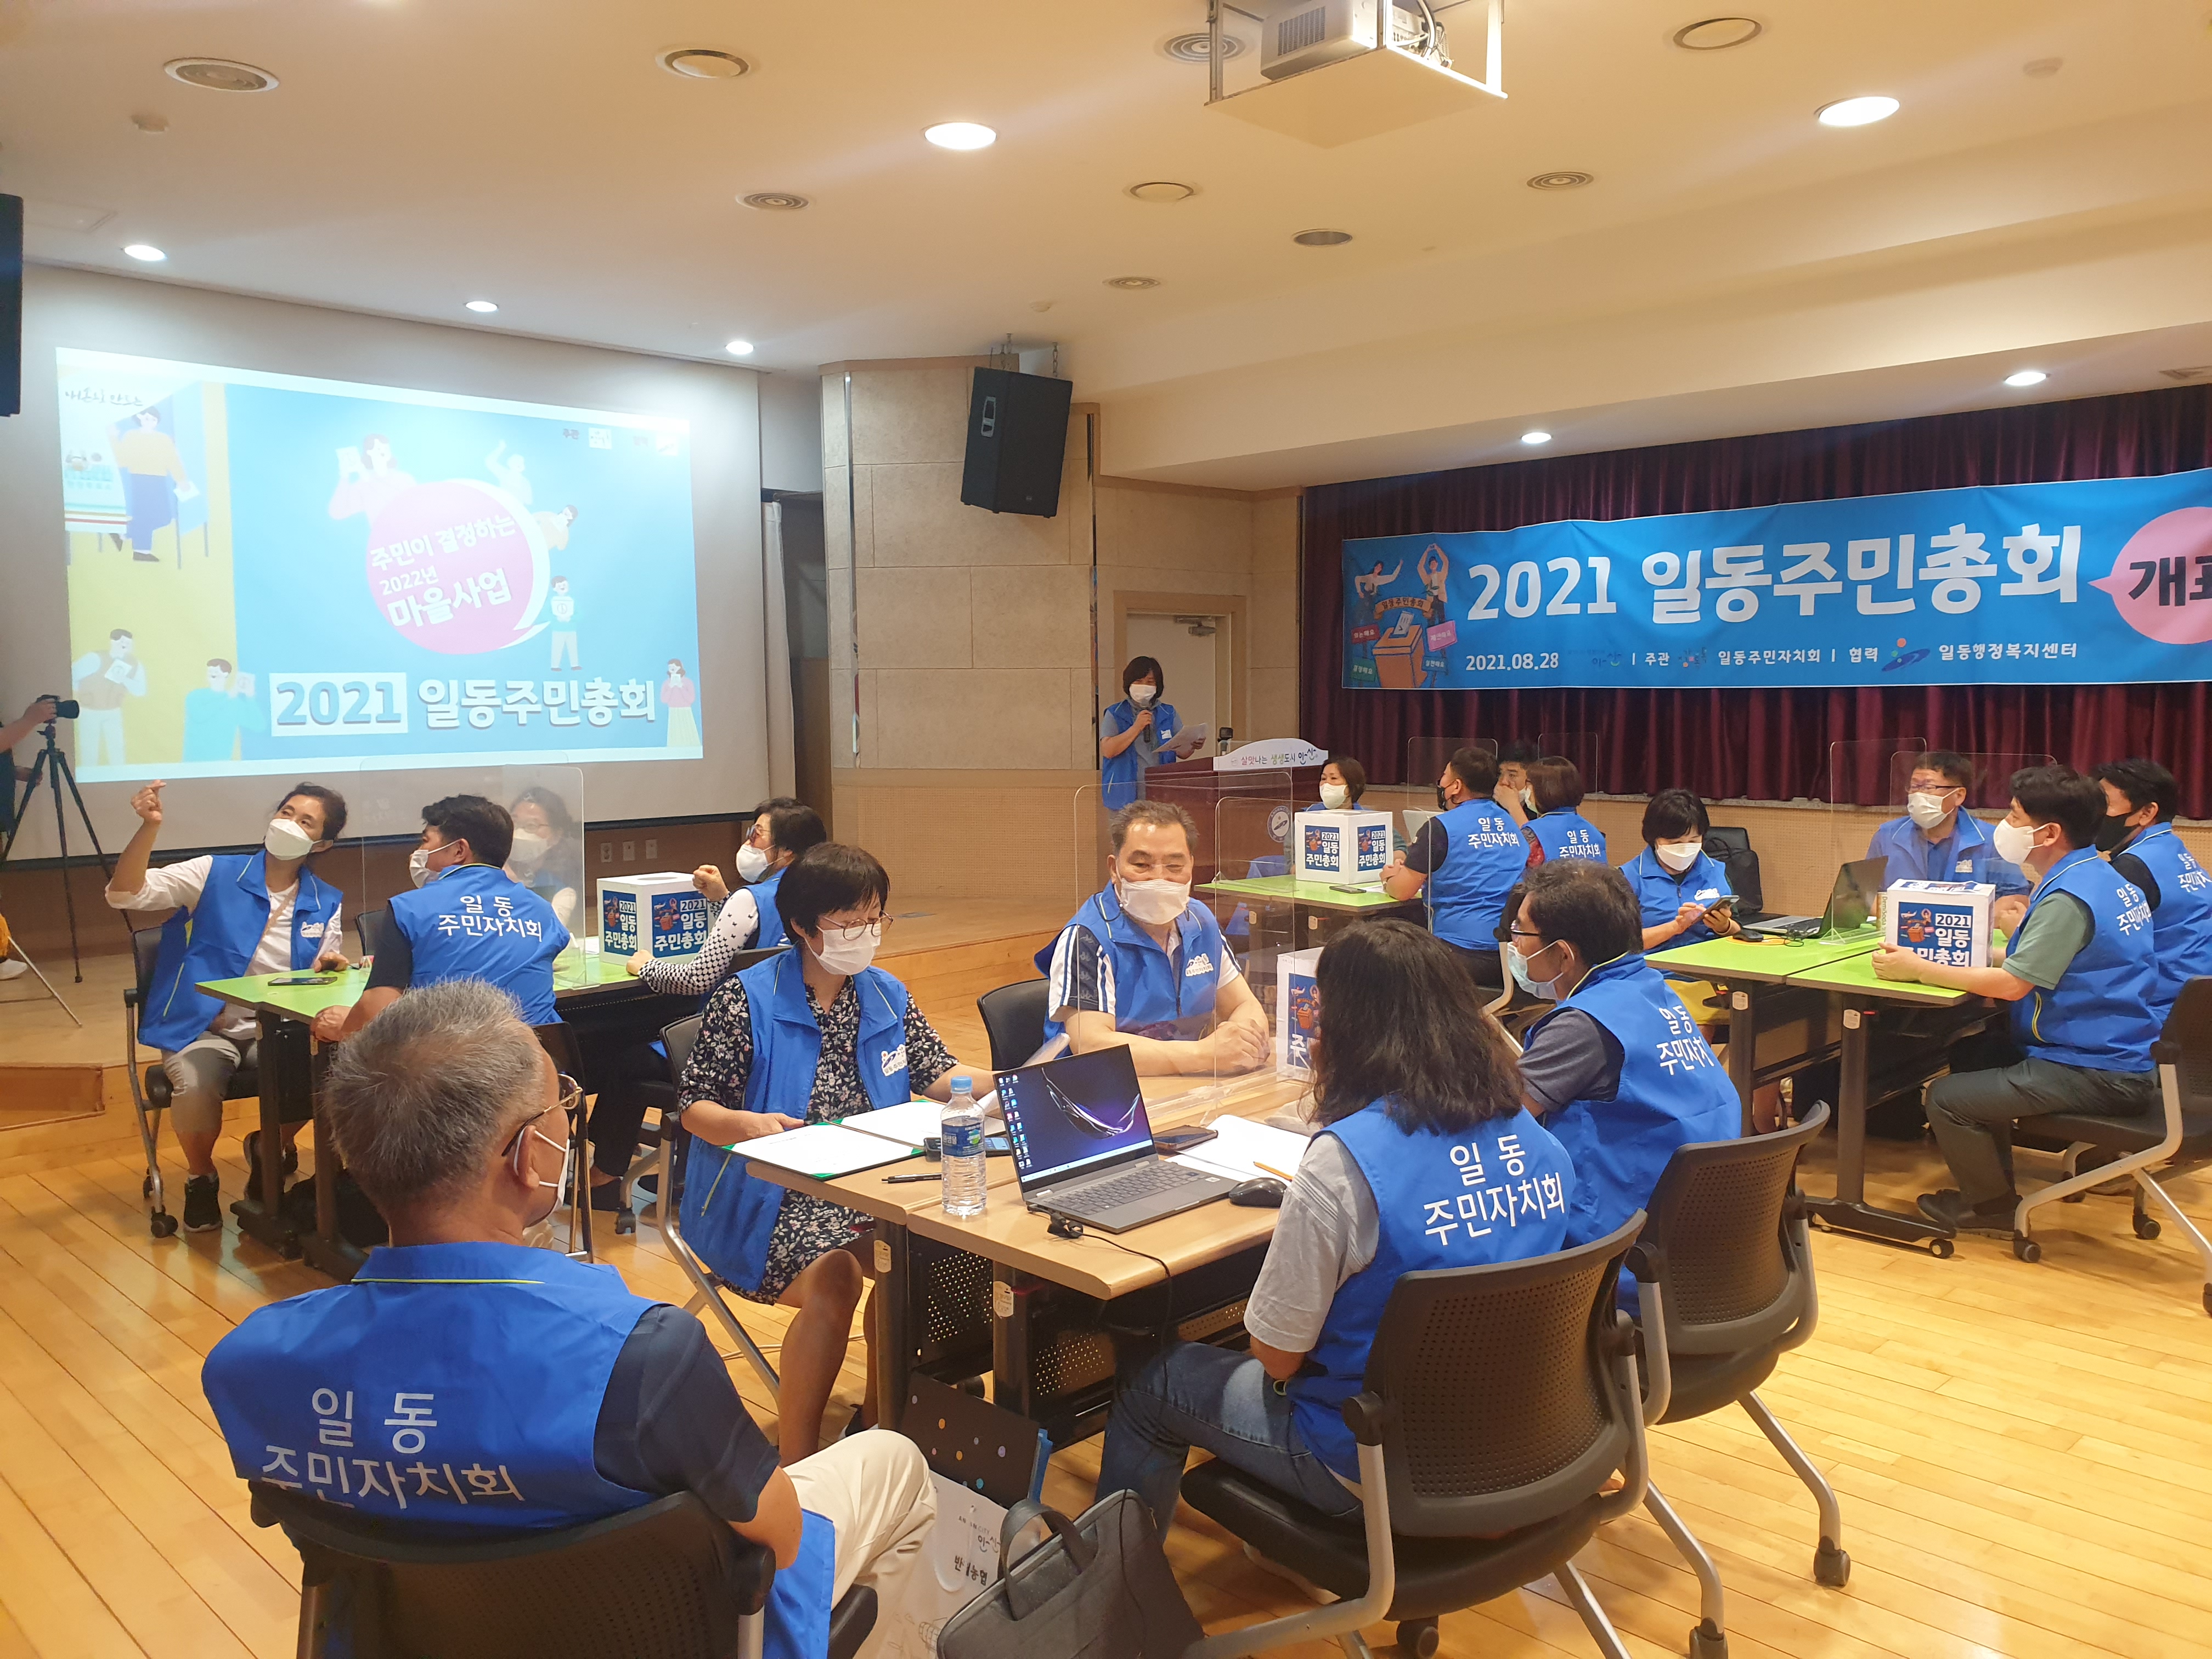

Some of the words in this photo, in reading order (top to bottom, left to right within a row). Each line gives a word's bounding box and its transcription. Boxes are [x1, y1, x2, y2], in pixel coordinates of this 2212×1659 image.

[370, 537, 434, 571] 주민이
[436, 515, 514, 554] 결정하는
[380, 566, 438, 596] 2022년
[1468, 556, 1617, 621] 2021
[1641, 523, 2081, 624] 일동주민총회
[387, 568, 511, 627] 마을사업
[1466, 652, 1559, 671] 2021.08.28
[1645, 652, 1669, 667] 주관
[1718, 648, 1821, 665] 일동주민자치회
[1849, 647, 1878, 663] 협력
[1938, 642, 2078, 661] 일동행정복지센터
[276, 681, 402, 725] 2021
[418, 676, 656, 729] 일동주민총회
[1241, 755, 1268, 765] 살맛나는
[1271, 753, 1295, 766] 생생도시
[1322, 832, 1339, 840] 2021
[1372, 839, 1386, 852] 일동
[1468, 832, 1520, 848] 주민자치회
[1322, 841, 1339, 854] 일동
[1559, 843, 1601, 858] 주민자치회
[1306, 854, 1339, 867] 주민총회
[1358, 853, 1386, 867] 주민총회
[620, 901, 636, 912] 2021
[681, 900, 706, 911] 2021
[437, 915, 543, 943] 주민자치회
[620, 914, 636, 932] 일동
[681, 911, 707, 930] 일동
[1936, 915, 1970, 927] 2021
[605, 930, 637, 951] 주민총회
[654, 929, 707, 951] 주민총회
[1935, 928, 1971, 948] 일동
[1423, 1172, 1565, 1246] 주민자치회
[261, 1444, 525, 1509] 주민자치회
